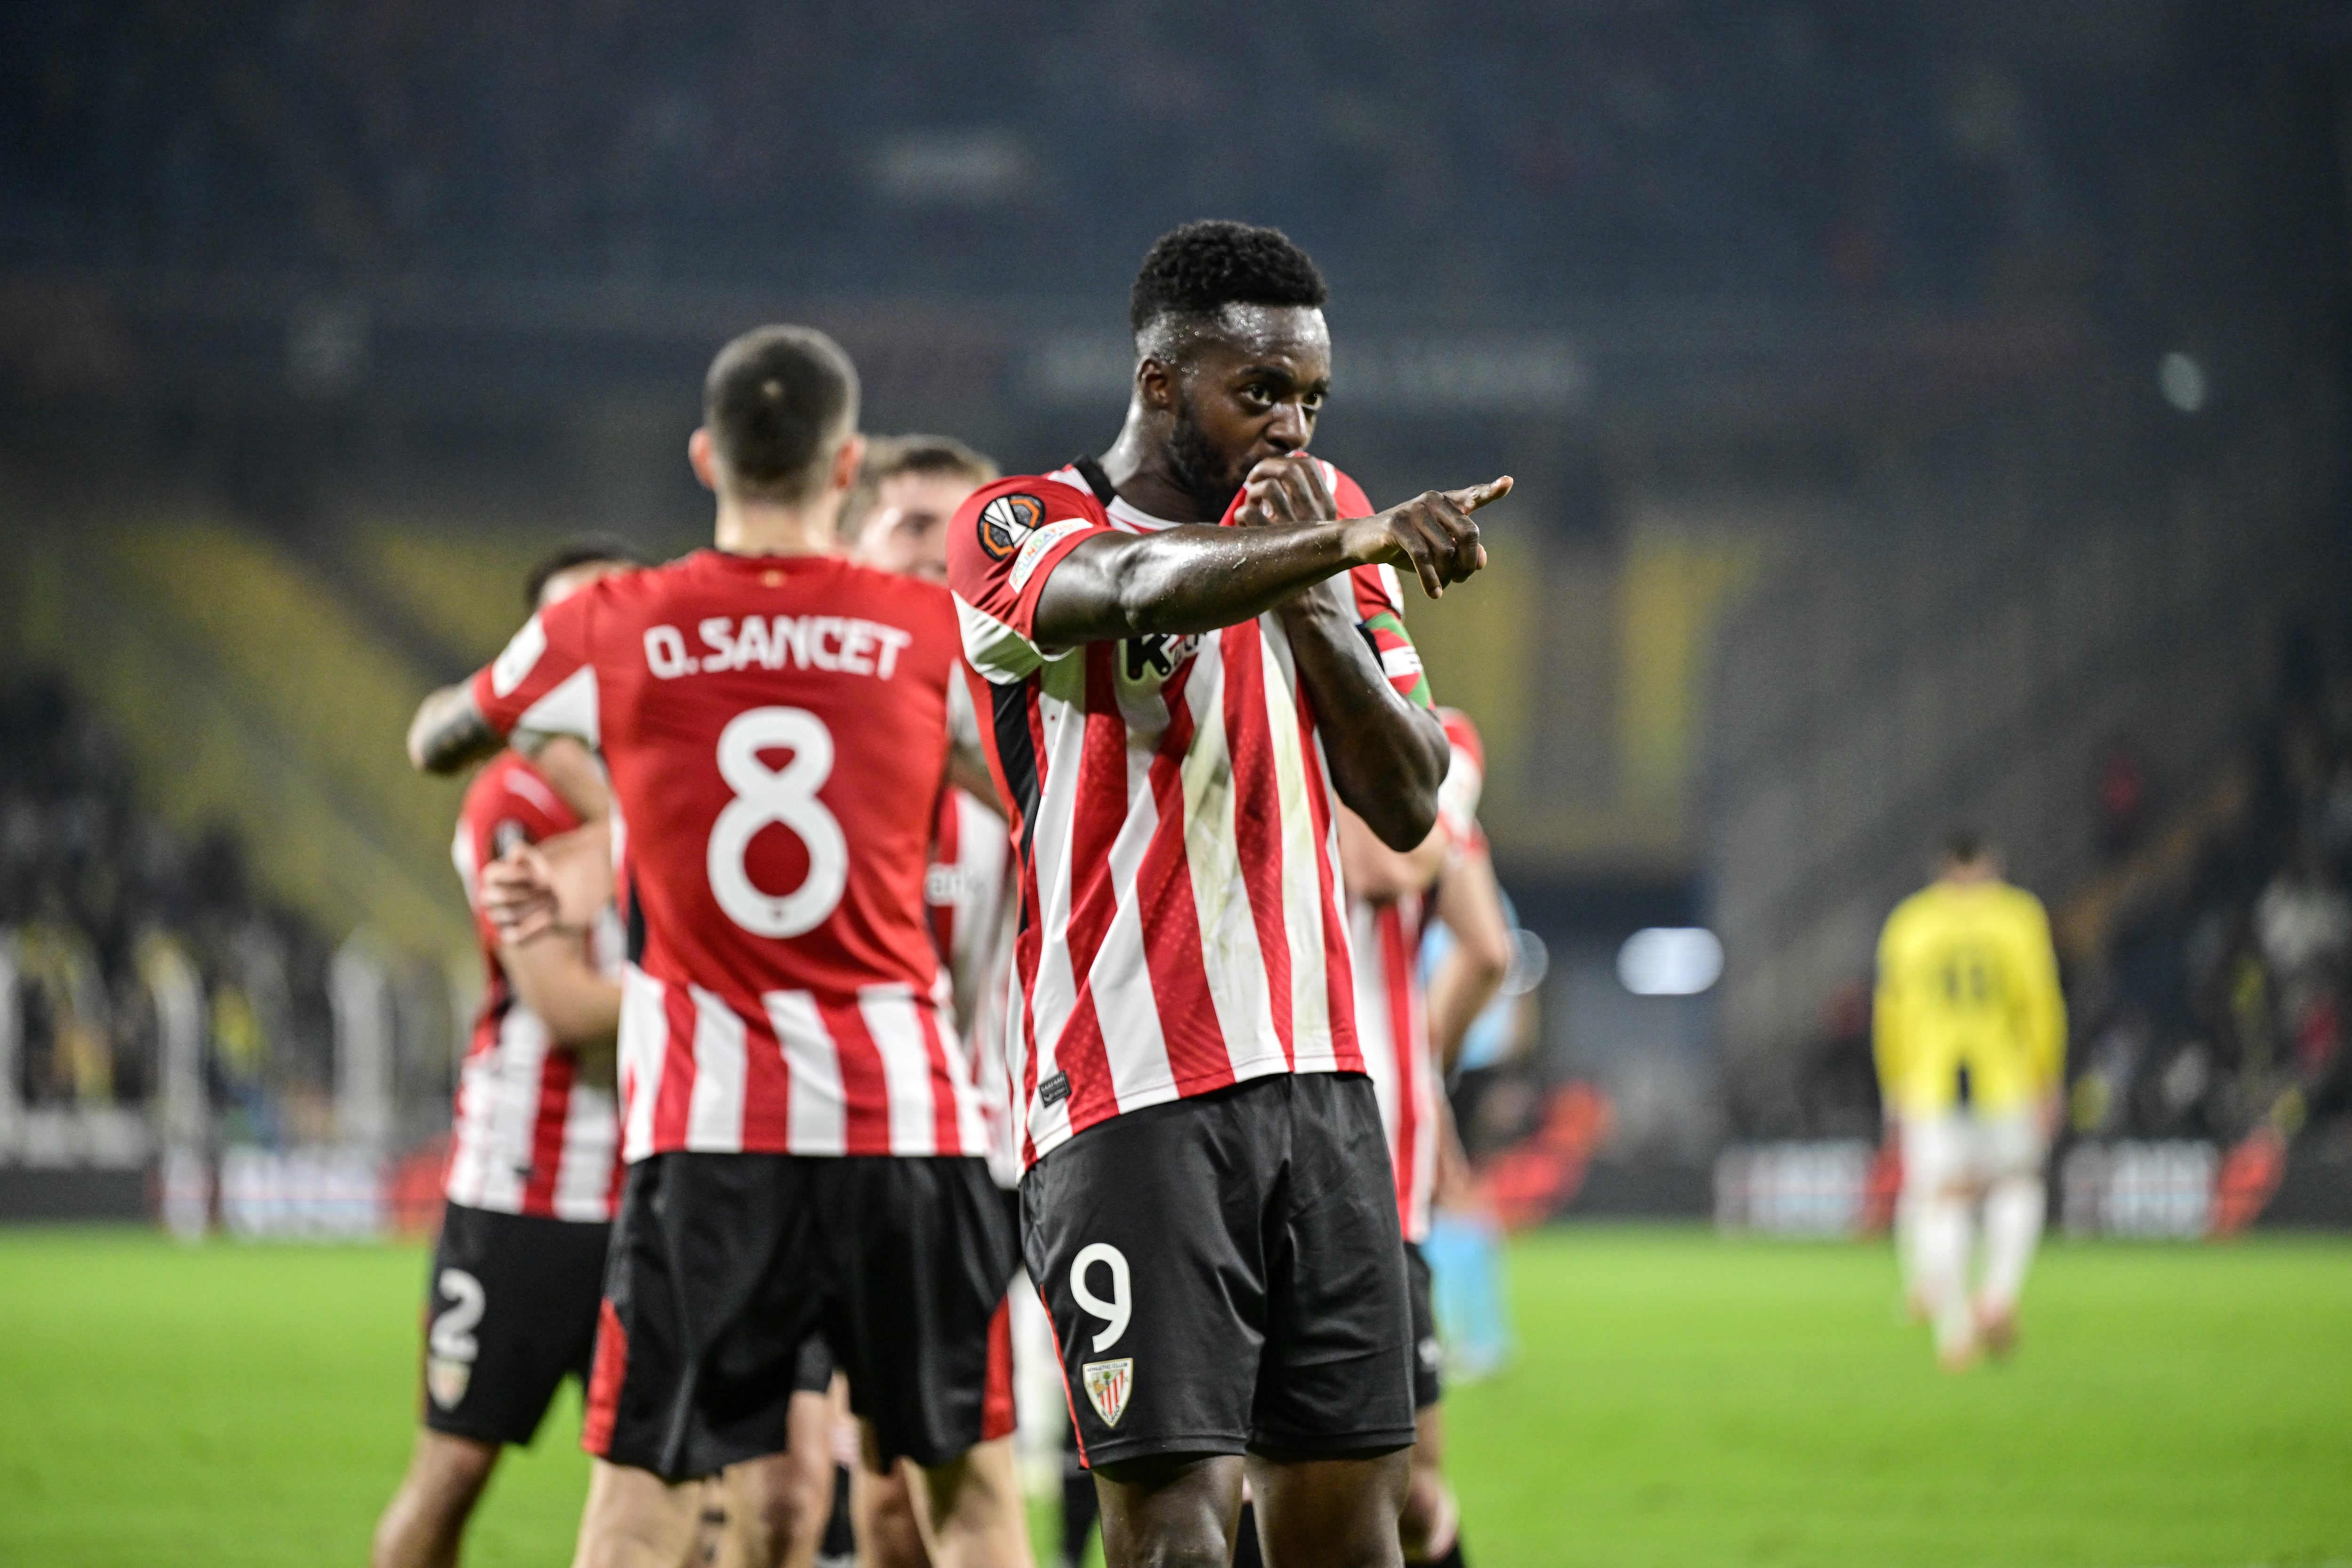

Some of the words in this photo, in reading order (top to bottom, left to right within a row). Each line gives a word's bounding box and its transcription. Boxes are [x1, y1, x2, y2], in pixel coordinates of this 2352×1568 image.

[643, 615, 913, 680] O.SANCET
[707, 706, 848, 939] 8
[432, 1268, 486, 1362] 2
[1070, 1242, 1132, 1353] 9
